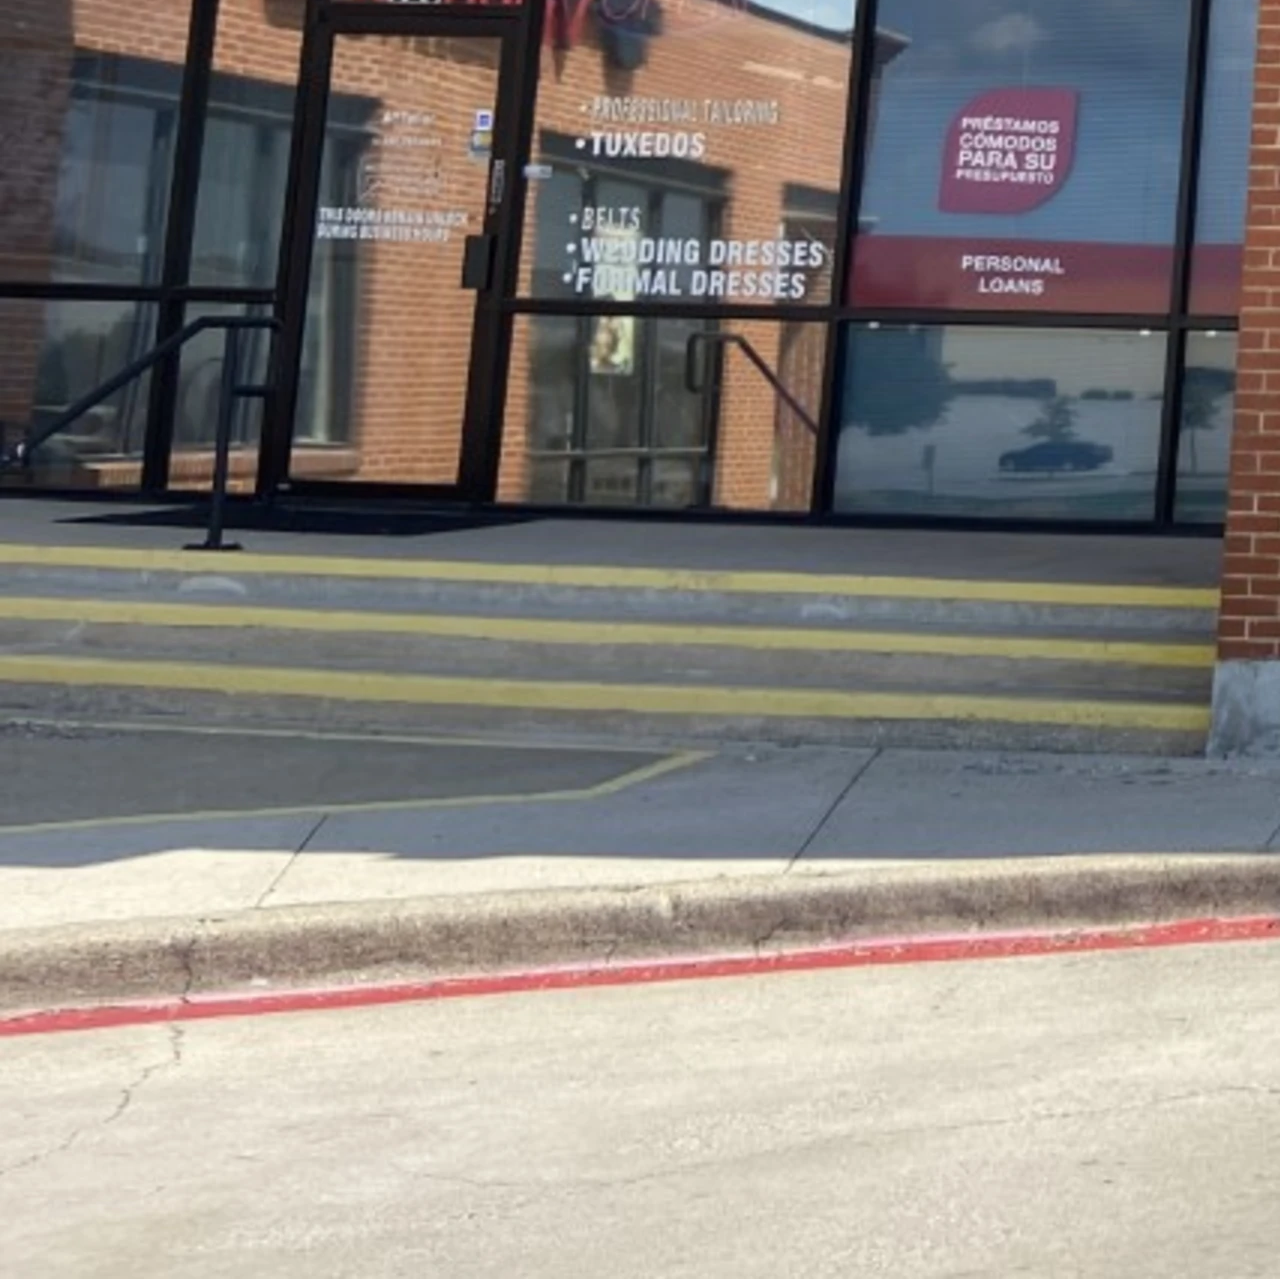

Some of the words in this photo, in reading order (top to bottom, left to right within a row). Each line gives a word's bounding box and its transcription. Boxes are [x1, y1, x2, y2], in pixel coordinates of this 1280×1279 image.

[591, 131, 706, 157] TUXEDOS
[958, 150, 1018, 170] PARA
[1025, 153, 1057, 171] SU
[581, 206, 641, 230] BELTS
[581, 237, 699, 264] WEDDING
[709, 239, 825, 268] DRESSES
[962, 254, 1065, 275] PERSONAL
[575, 266, 682, 297] FORMAL
[690, 269, 805, 298] DRESSES
[978, 276, 1044, 296] LOANS
